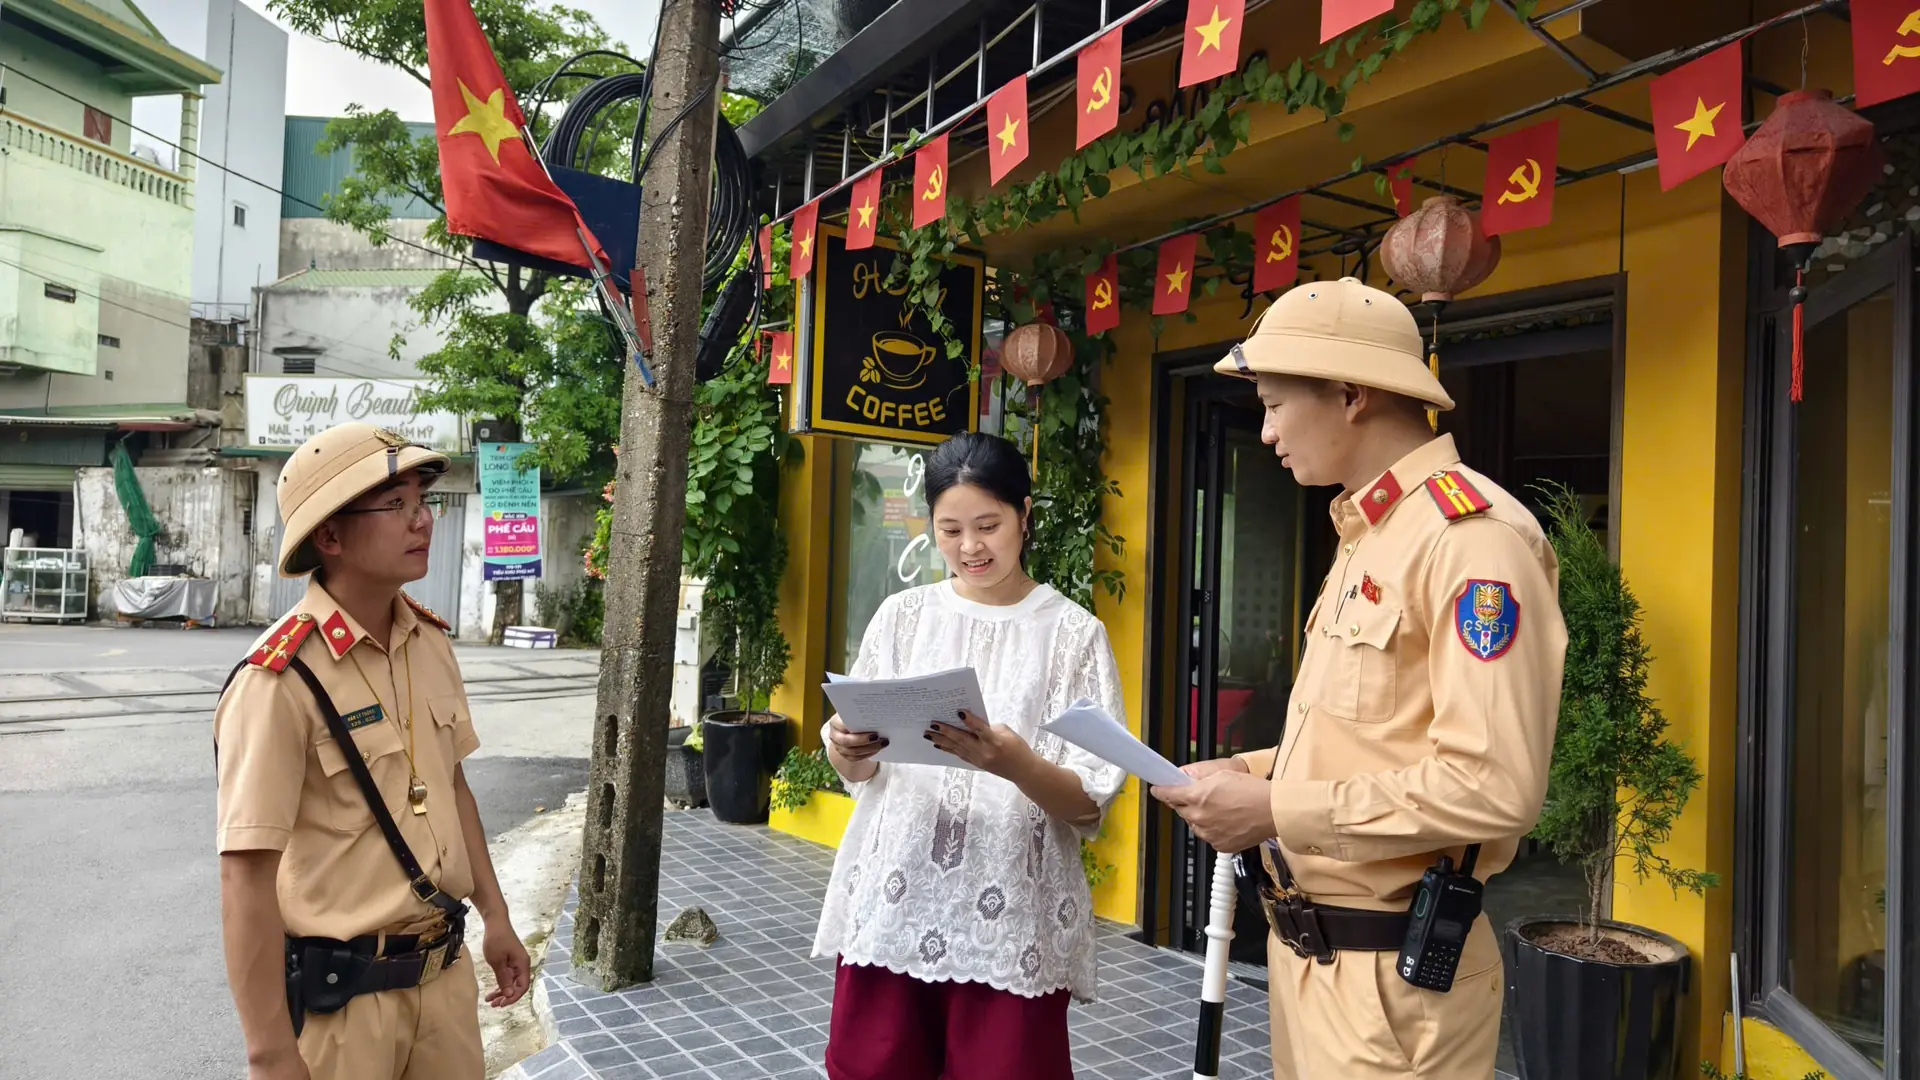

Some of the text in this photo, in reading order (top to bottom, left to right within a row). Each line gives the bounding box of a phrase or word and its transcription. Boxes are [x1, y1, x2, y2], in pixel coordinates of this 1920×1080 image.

[273, 382, 422, 424] Quỳnh Beauty
[846, 385, 946, 426] COFFEE
[268, 424, 291, 435] NAIL
[303, 424, 315, 436] MI
[488, 522, 511, 534] PHẾ
[1463, 620, 1510, 635] CSGT
